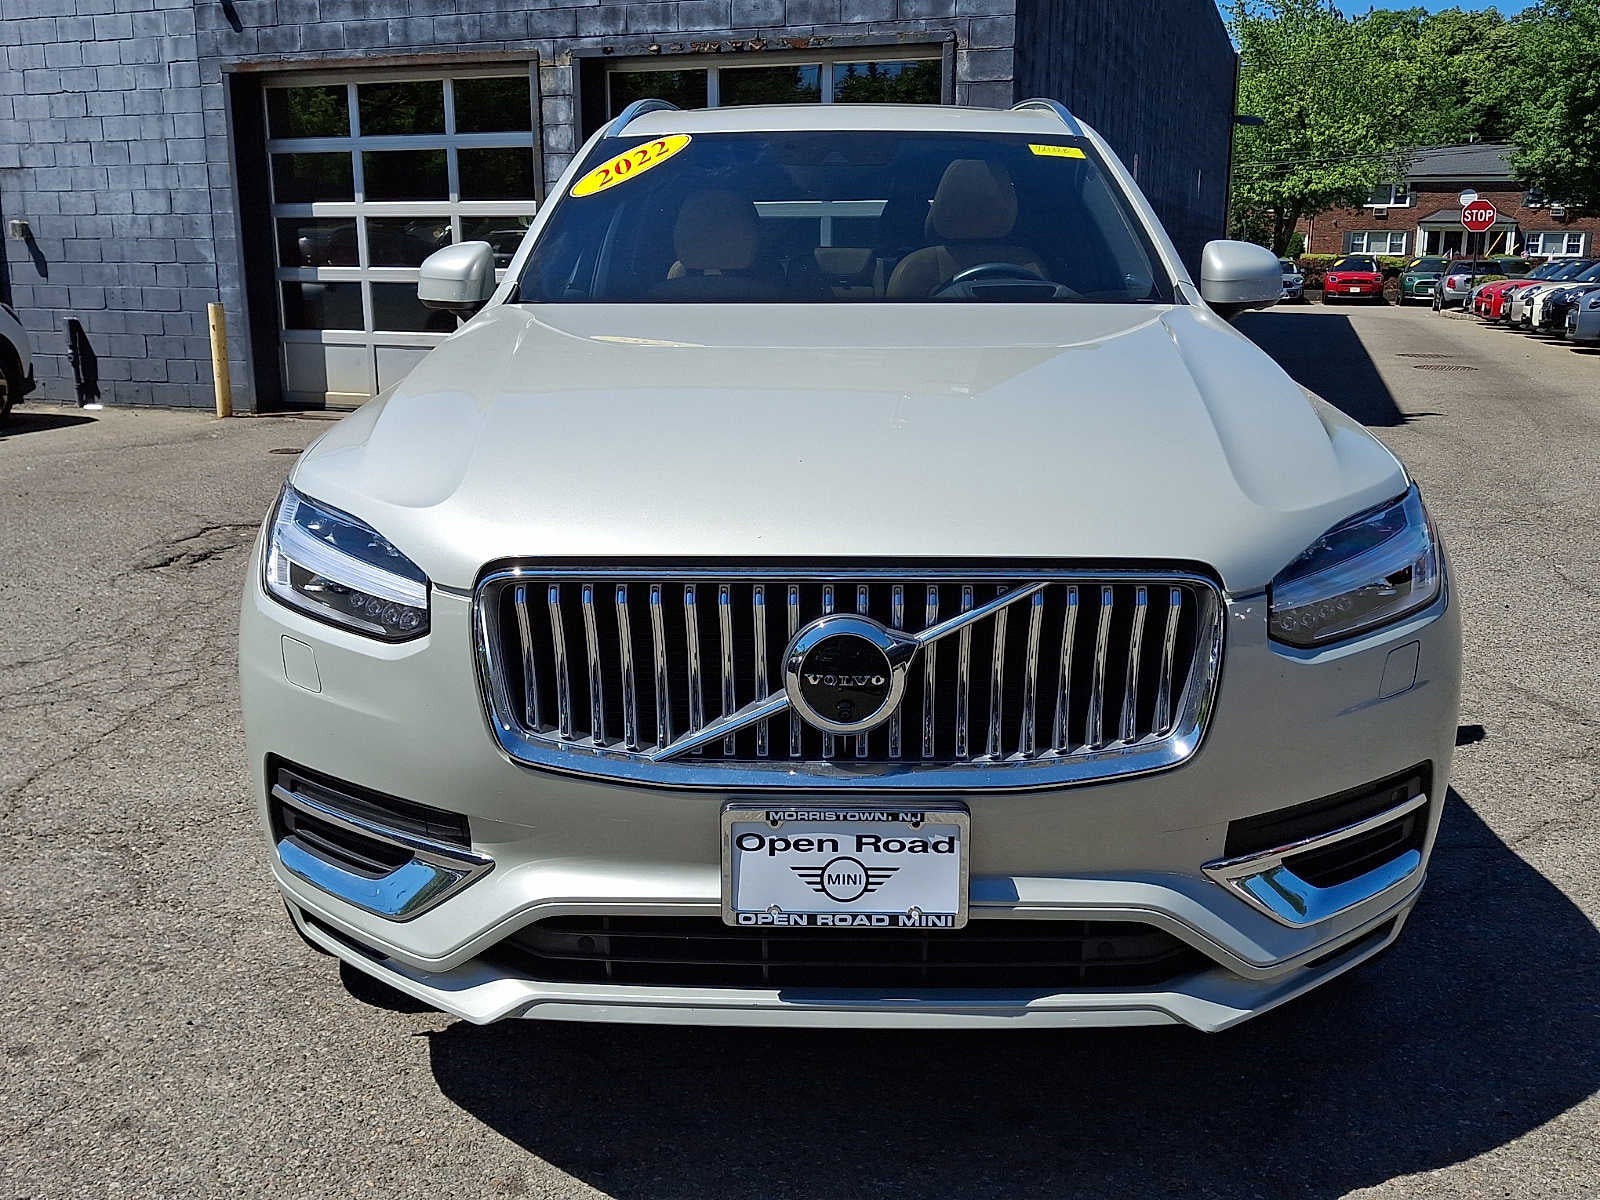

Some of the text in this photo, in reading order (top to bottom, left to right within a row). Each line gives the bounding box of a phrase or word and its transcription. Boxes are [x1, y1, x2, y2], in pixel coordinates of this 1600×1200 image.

[596, 141, 669, 187] 2022
[1464, 209, 1493, 222] STOP
[804, 673, 885, 686] VOLVO
[769, 811, 922, 822] MORRISTOWN, NJ
[735, 832, 955, 857] Open Road
[827, 873, 862, 886] MINI
[738, 912, 953, 927] OPEN ROAD MINI
